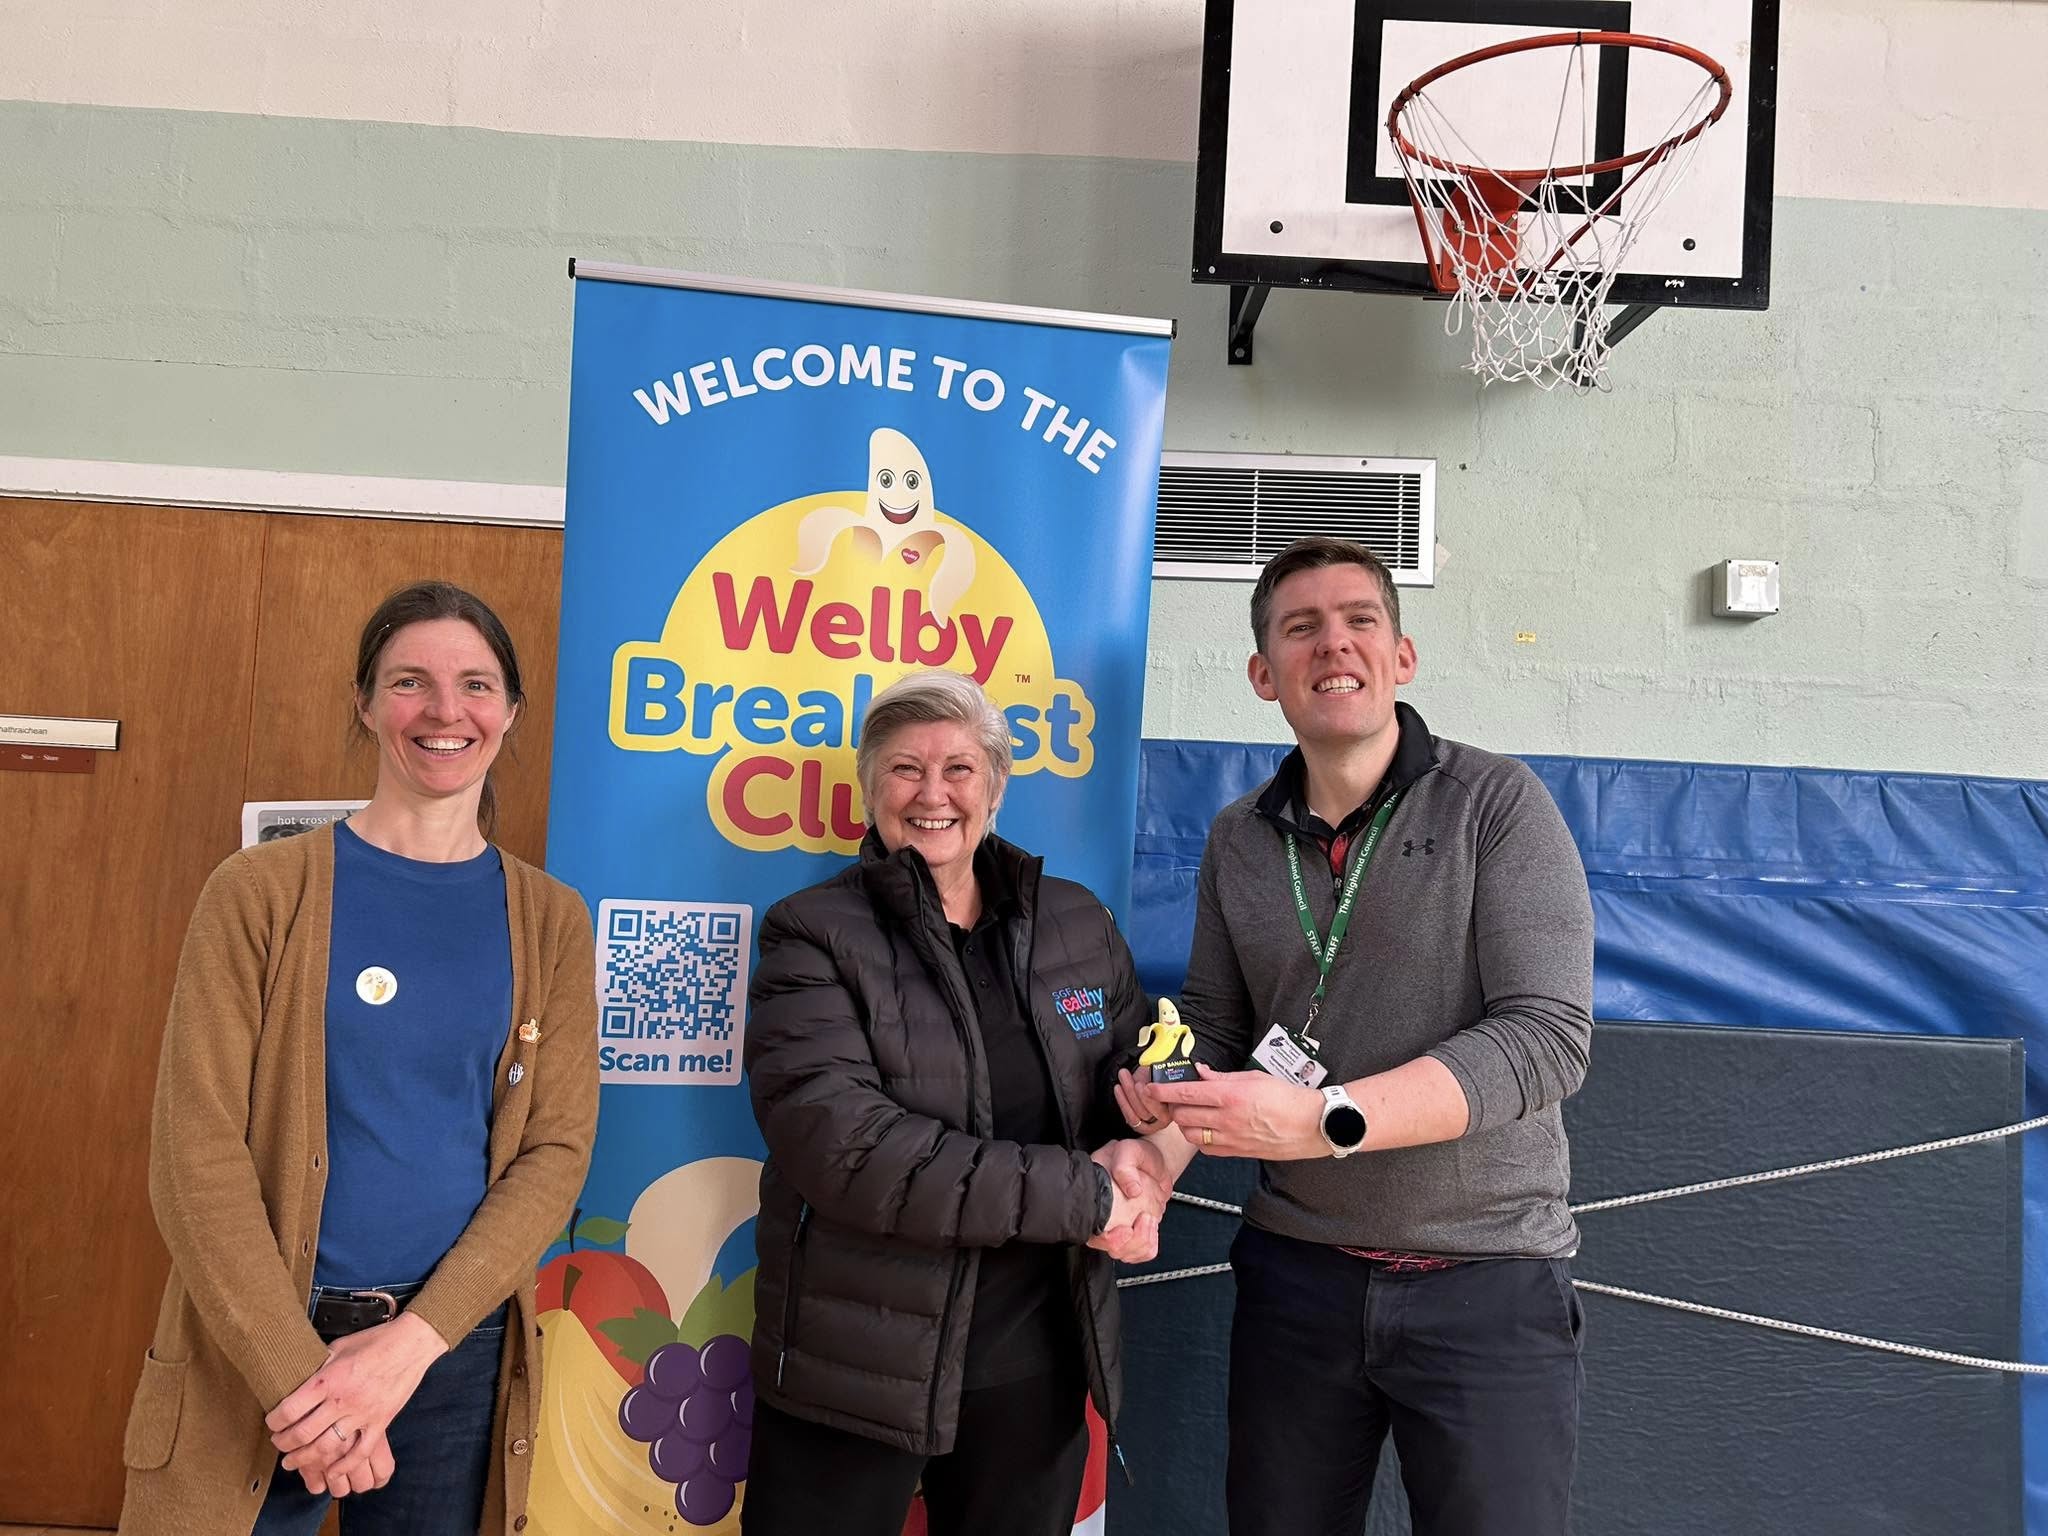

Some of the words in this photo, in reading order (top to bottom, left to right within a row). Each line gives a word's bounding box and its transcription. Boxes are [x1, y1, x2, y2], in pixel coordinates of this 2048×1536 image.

[632, 343, 917, 425] WELCOME
[932, 355, 1006, 412] TO
[1022, 386, 1117, 474] THE
[712, 572, 1014, 686] Welby
[624, 656, 1082, 763] Breast
[722, 755, 868, 840] Clu
[277, 815, 296, 825] hot
[299, 816, 328, 825] cross
[1287, 844, 1300, 880] Highland
[1338, 897, 1352, 914] The
[1345, 857, 1366, 897] Highland
[1361, 826, 1379, 857] Council
[1293, 880, 1308, 911] Council
[1306, 930, 1322, 957] STAFF
[1325, 935, 1339, 963] STAFF
[1065, 1010, 1105, 1032] living
[599, 1046, 670, 1072] Scan
[678, 1049, 733, 1073] me!
